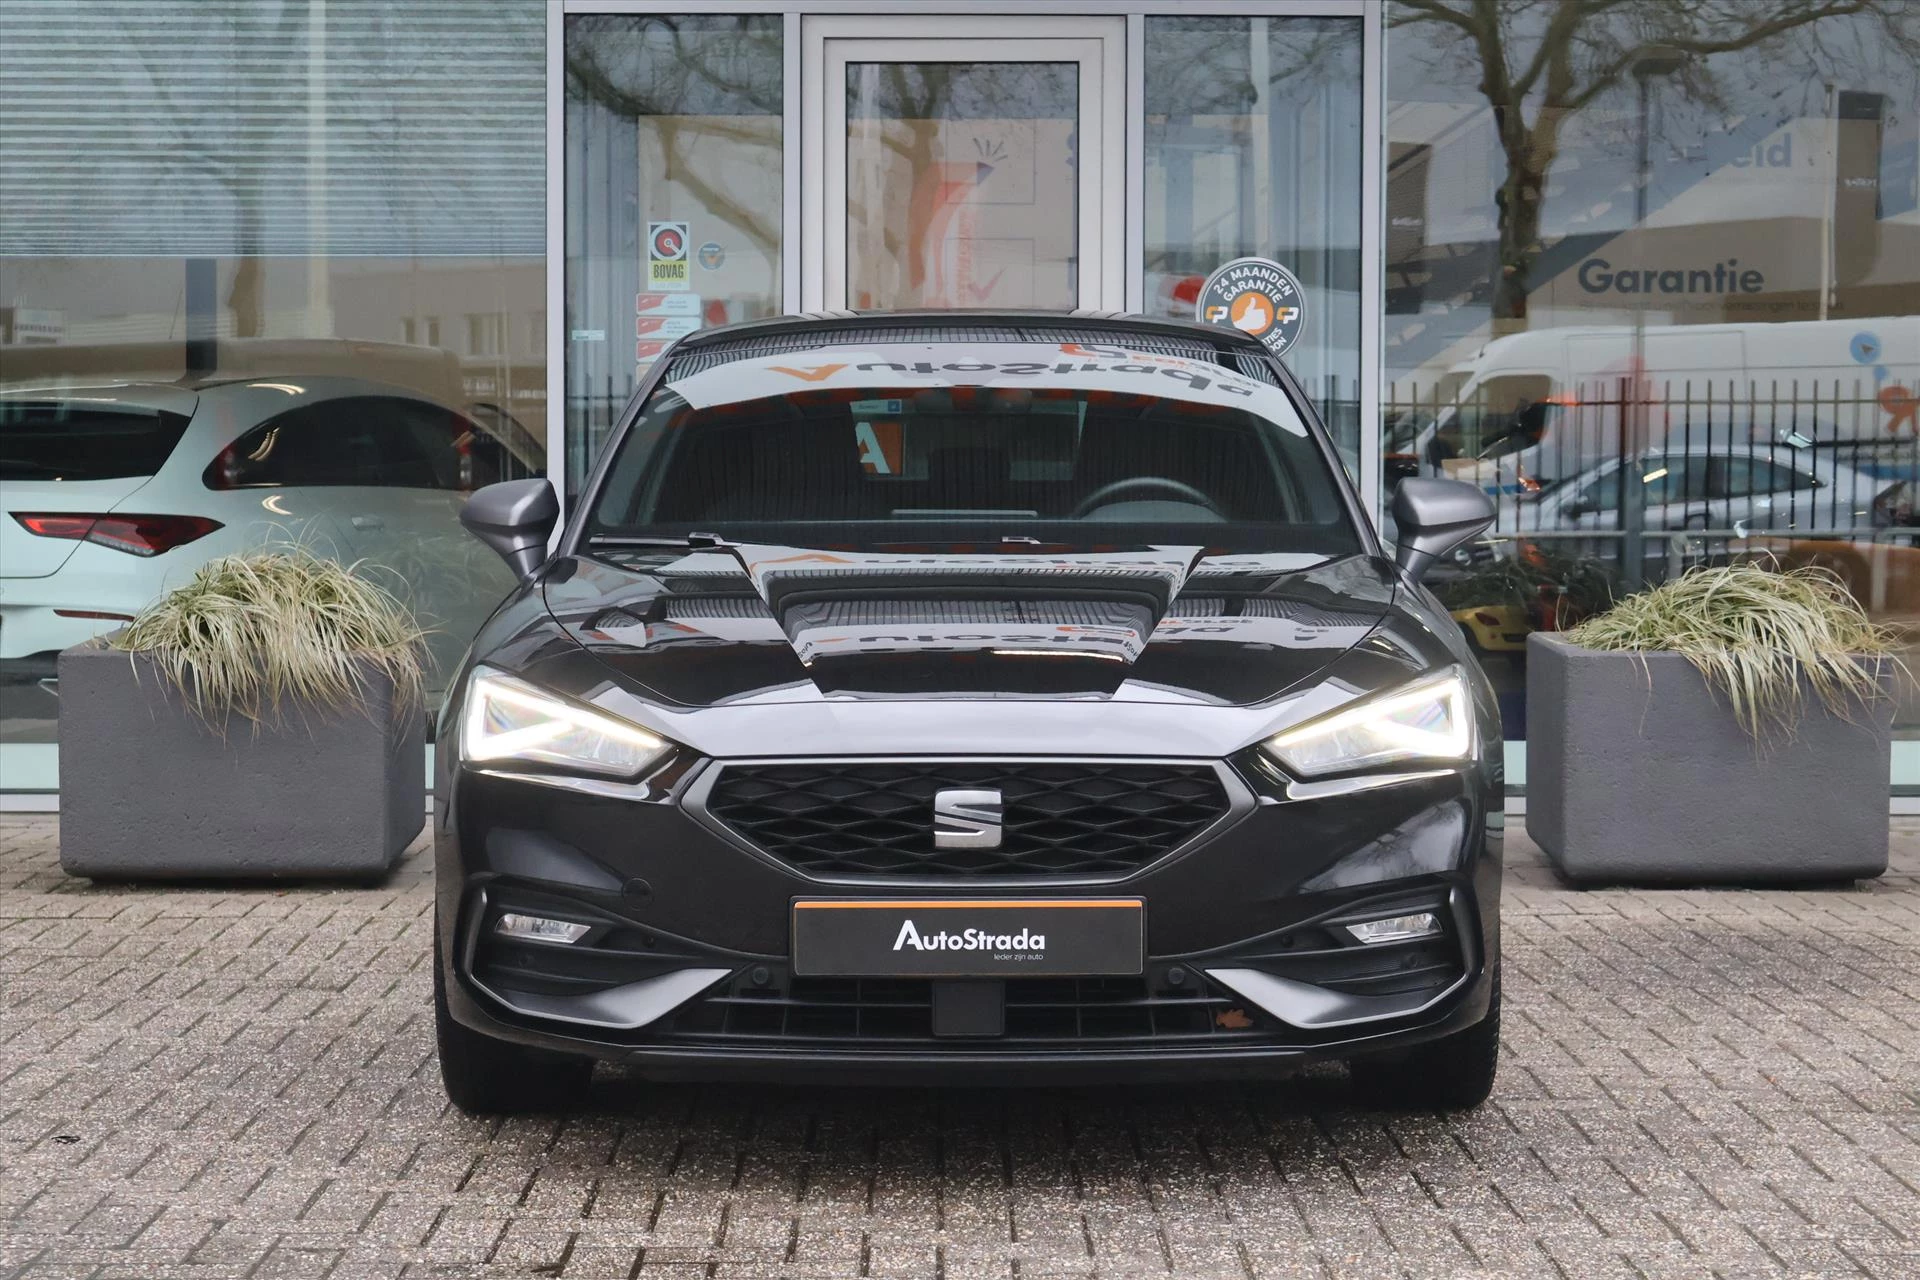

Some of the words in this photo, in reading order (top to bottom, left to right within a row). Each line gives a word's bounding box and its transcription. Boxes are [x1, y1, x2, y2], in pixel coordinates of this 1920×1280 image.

[653, 264, 684, 279] BOVAG
[1213, 277, 1231, 294] 24
[1231, 267, 1293, 296] MAANDEN
[1578, 259, 1764, 294] Garantie
[1223, 279, 1283, 303] GARANTIE
[892, 919, 1046, 951] AutoStrada
[1014, 953, 1026, 962] zijn
